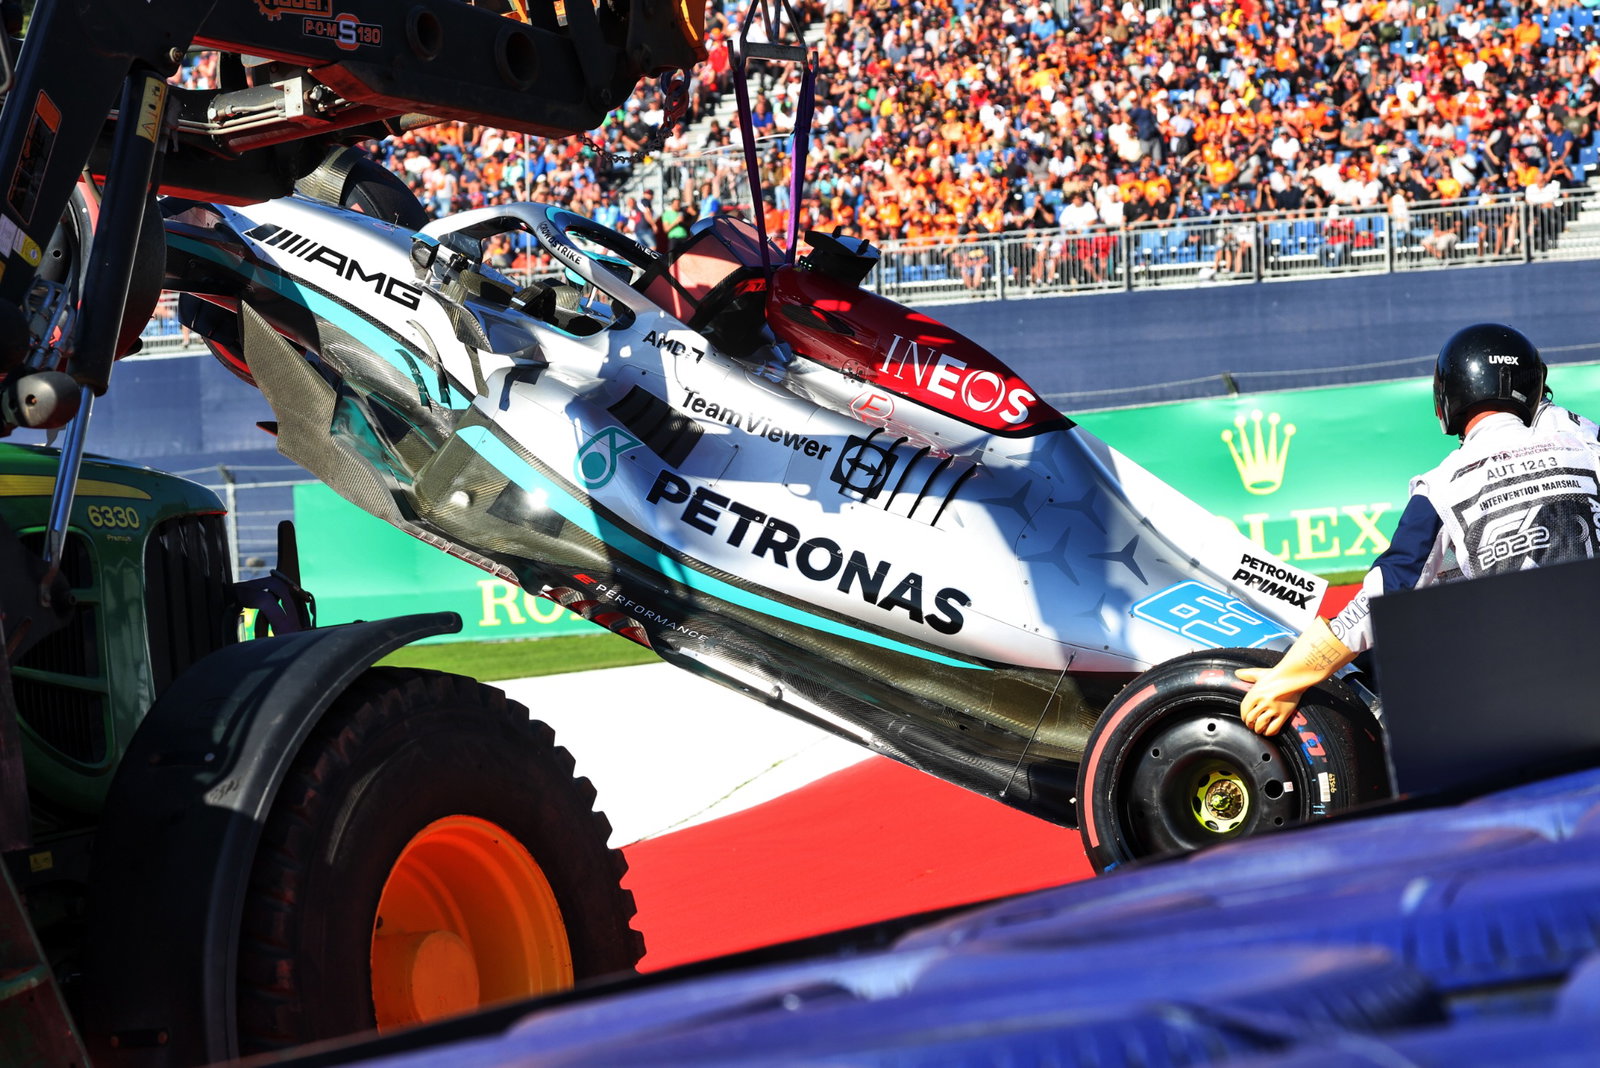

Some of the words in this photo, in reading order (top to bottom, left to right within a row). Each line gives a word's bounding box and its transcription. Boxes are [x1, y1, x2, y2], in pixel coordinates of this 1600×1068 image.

[358, 26, 381, 44] 130
[537, 220, 583, 265] CROWDSTRIKE
[634, 242, 661, 260] INEO
[304, 245, 424, 311] AMG
[643, 330, 687, 356] AMD
[1488, 355, 1519, 366] uvex
[878, 333, 1037, 425] INEOS
[682, 387, 832, 461] TeamViewer
[1487, 463, 1515, 481] AUT
[87, 504, 140, 528] 6330
[1479, 485, 1540, 512] INTERVENTION
[1542, 479, 1582, 492] MARSHAL
[645, 469, 972, 635] PETRONAS
[1219, 502, 1392, 562] LEX
[1477, 525, 1551, 571] 2022
[1232, 568, 1317, 611] PRIMAX
[1240, 553, 1316, 593] PETRONAS
[595, 583, 709, 642] PERFORMANCE
